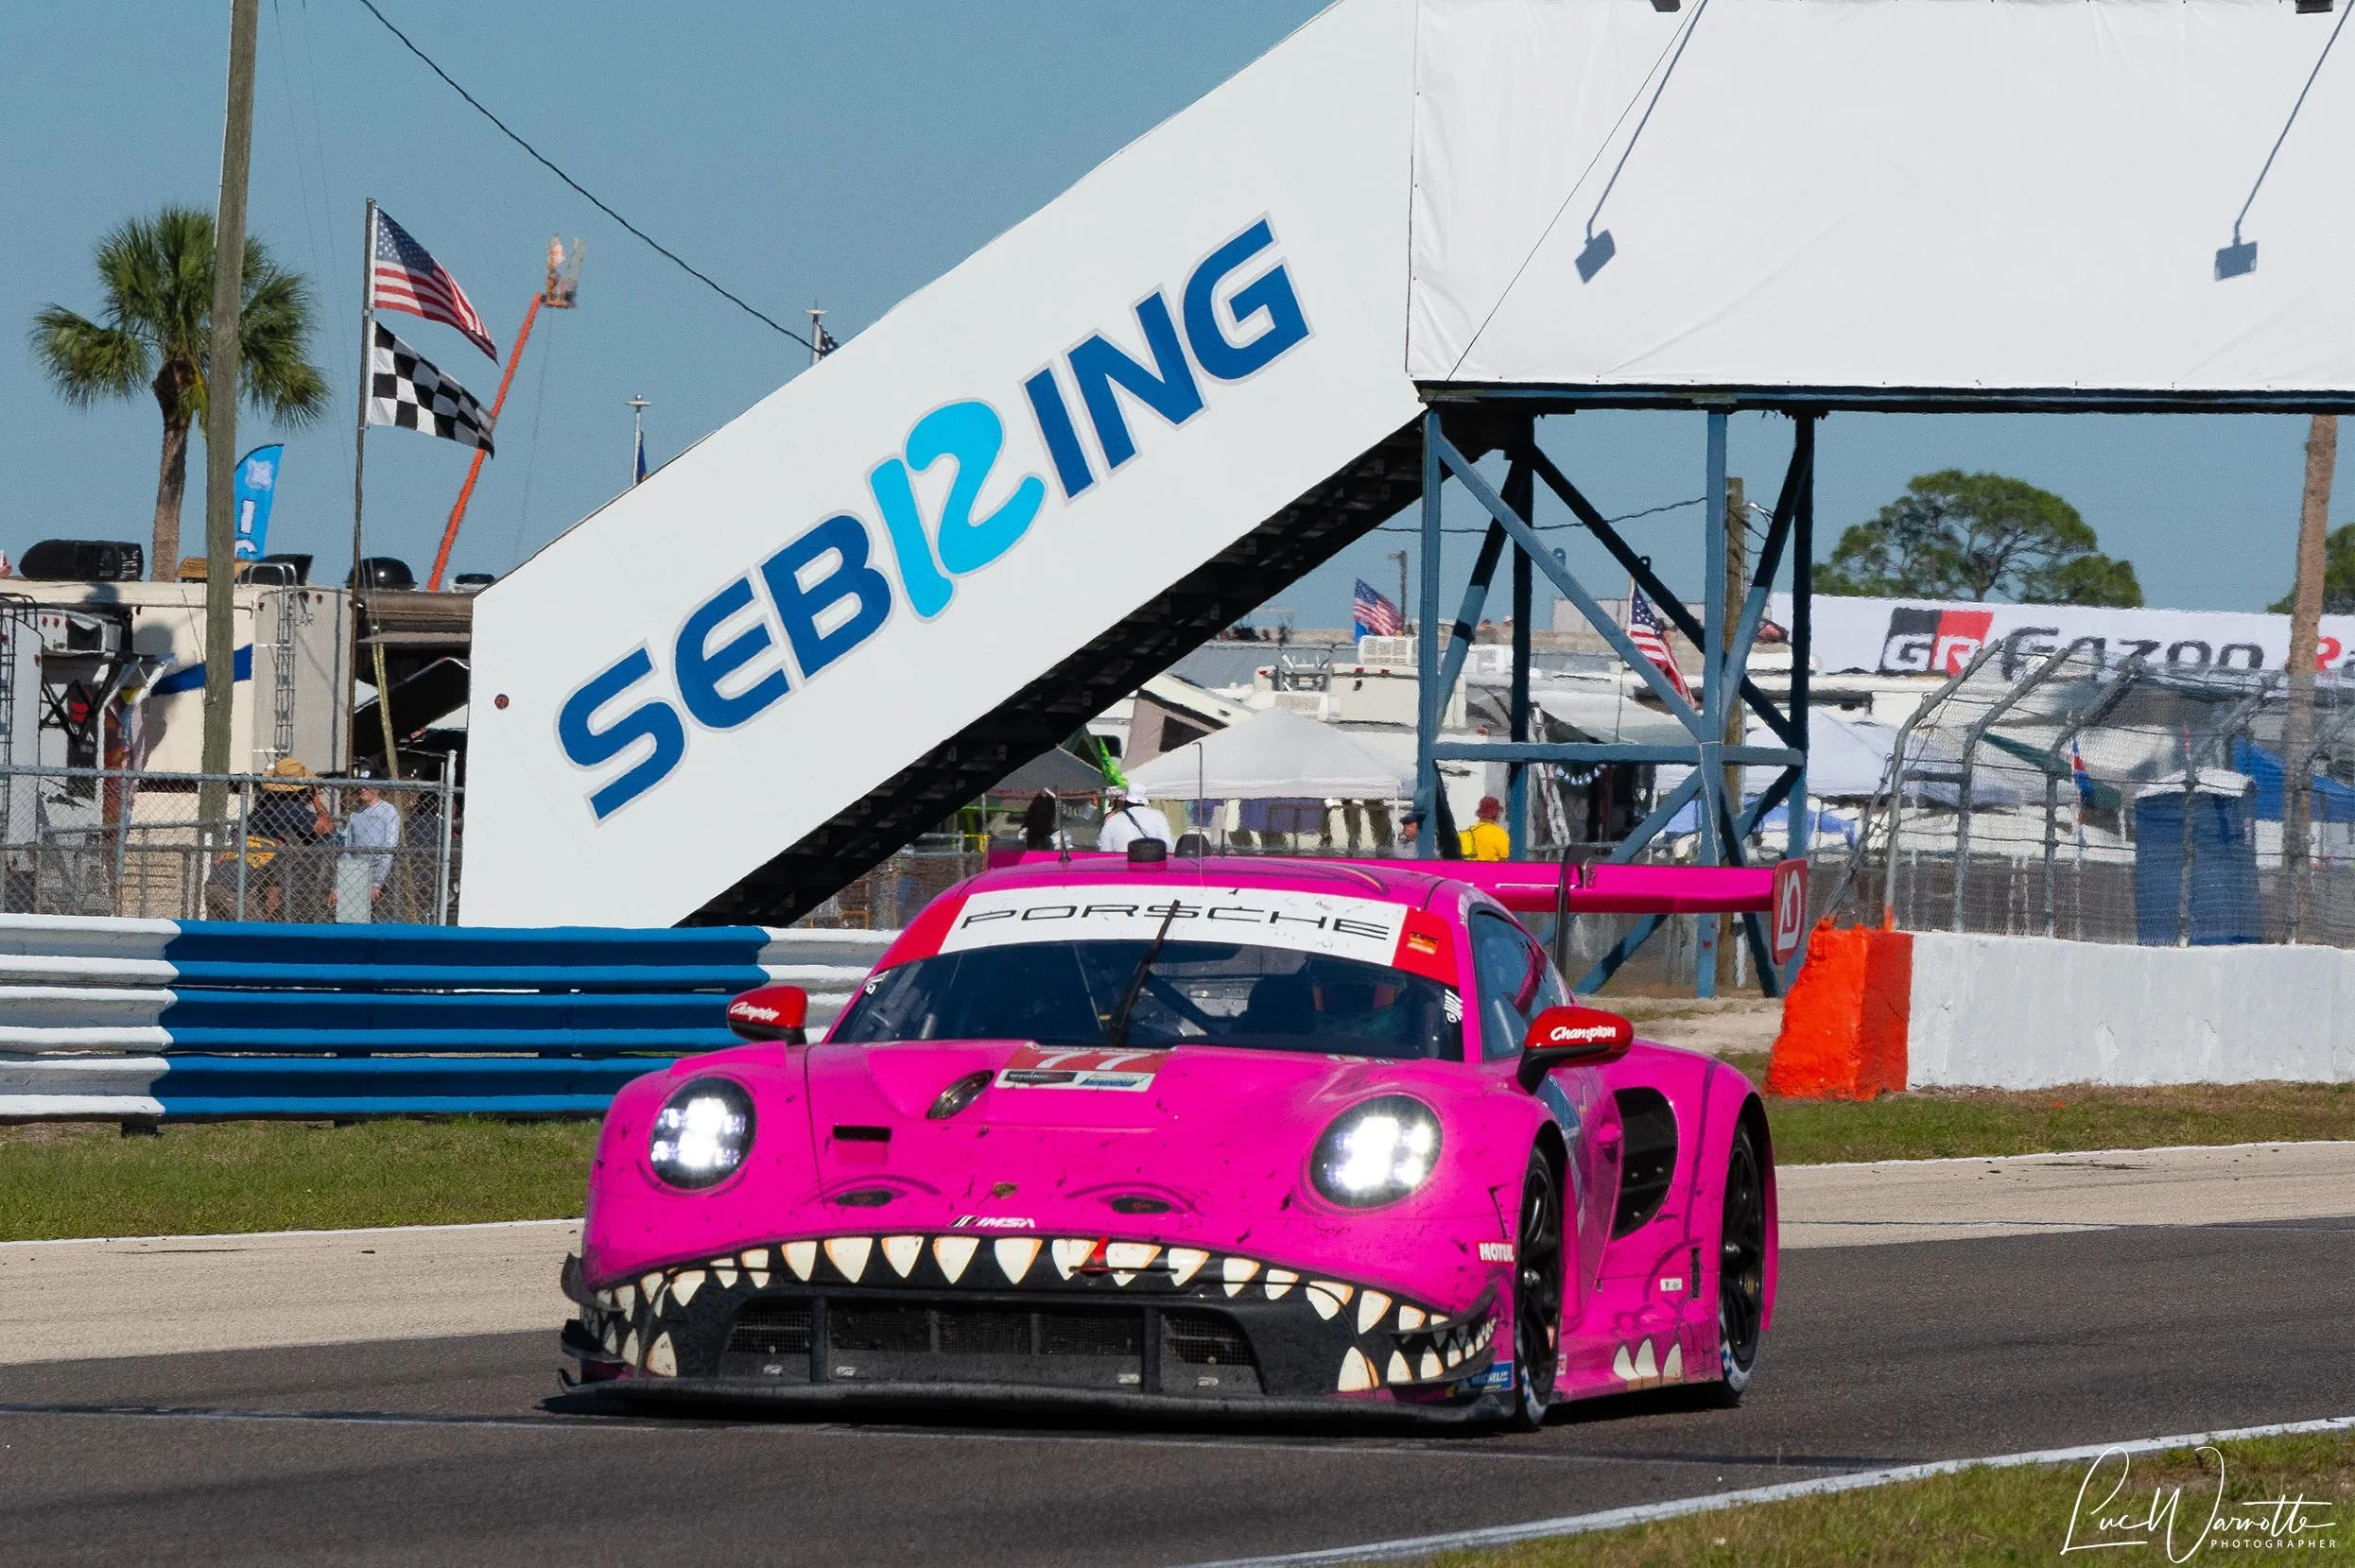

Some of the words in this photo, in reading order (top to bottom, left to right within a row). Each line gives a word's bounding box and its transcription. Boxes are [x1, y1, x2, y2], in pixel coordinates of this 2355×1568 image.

[1883, 632, 1983, 672] GR
[961, 903, 1390, 940] PORSCHE
[1550, 1025, 1617, 1042] Champion
[1036, 1050, 1152, 1071] 77
[975, 1216, 1035, 1229] IMSA
[1479, 1242, 1515, 1263] MOTUL
